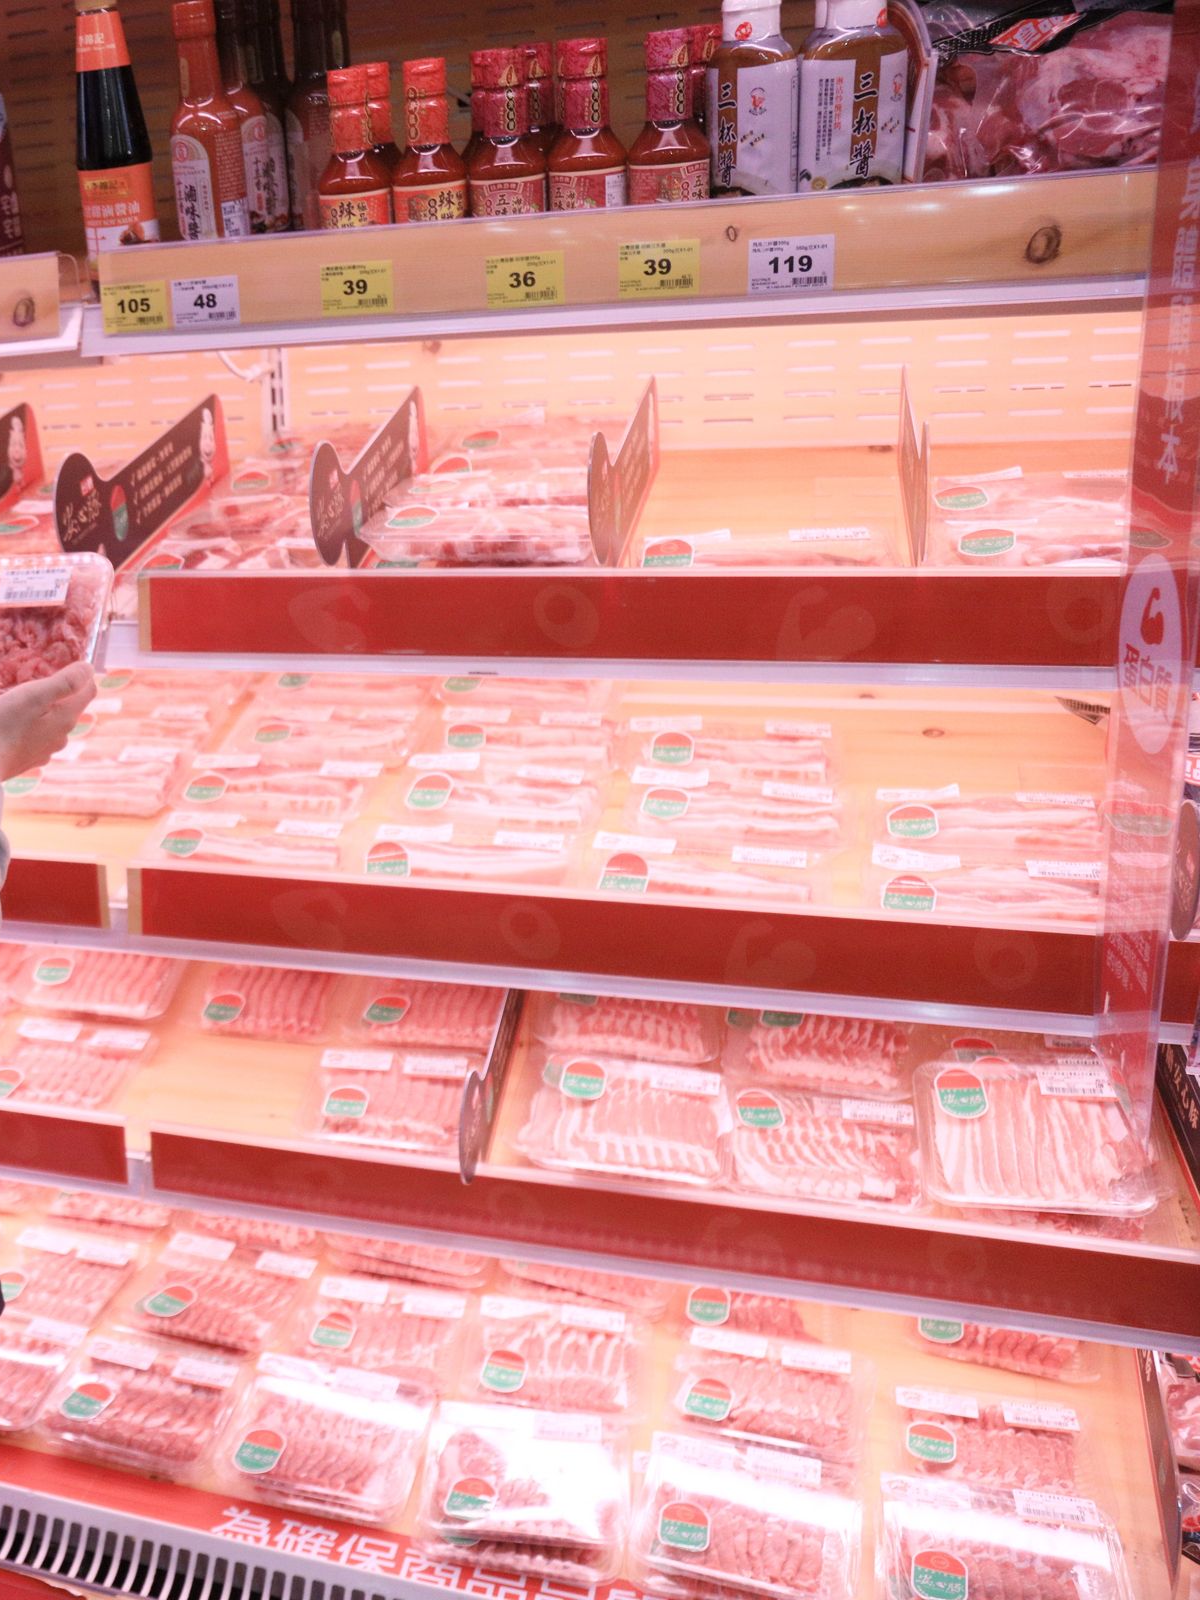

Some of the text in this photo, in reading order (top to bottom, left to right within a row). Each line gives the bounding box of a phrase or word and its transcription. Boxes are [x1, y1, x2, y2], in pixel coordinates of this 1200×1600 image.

[850, 72, 879, 178] 三杯醬
[717, 82, 738, 188] 三杯醬
[643, 258, 672, 276] 39
[768, 255, 813, 274] 119
[343, 279, 368, 296] 39
[509, 271, 536, 289] 36
[117, 298, 150, 314] 105
[193, 293, 217, 309] 48
